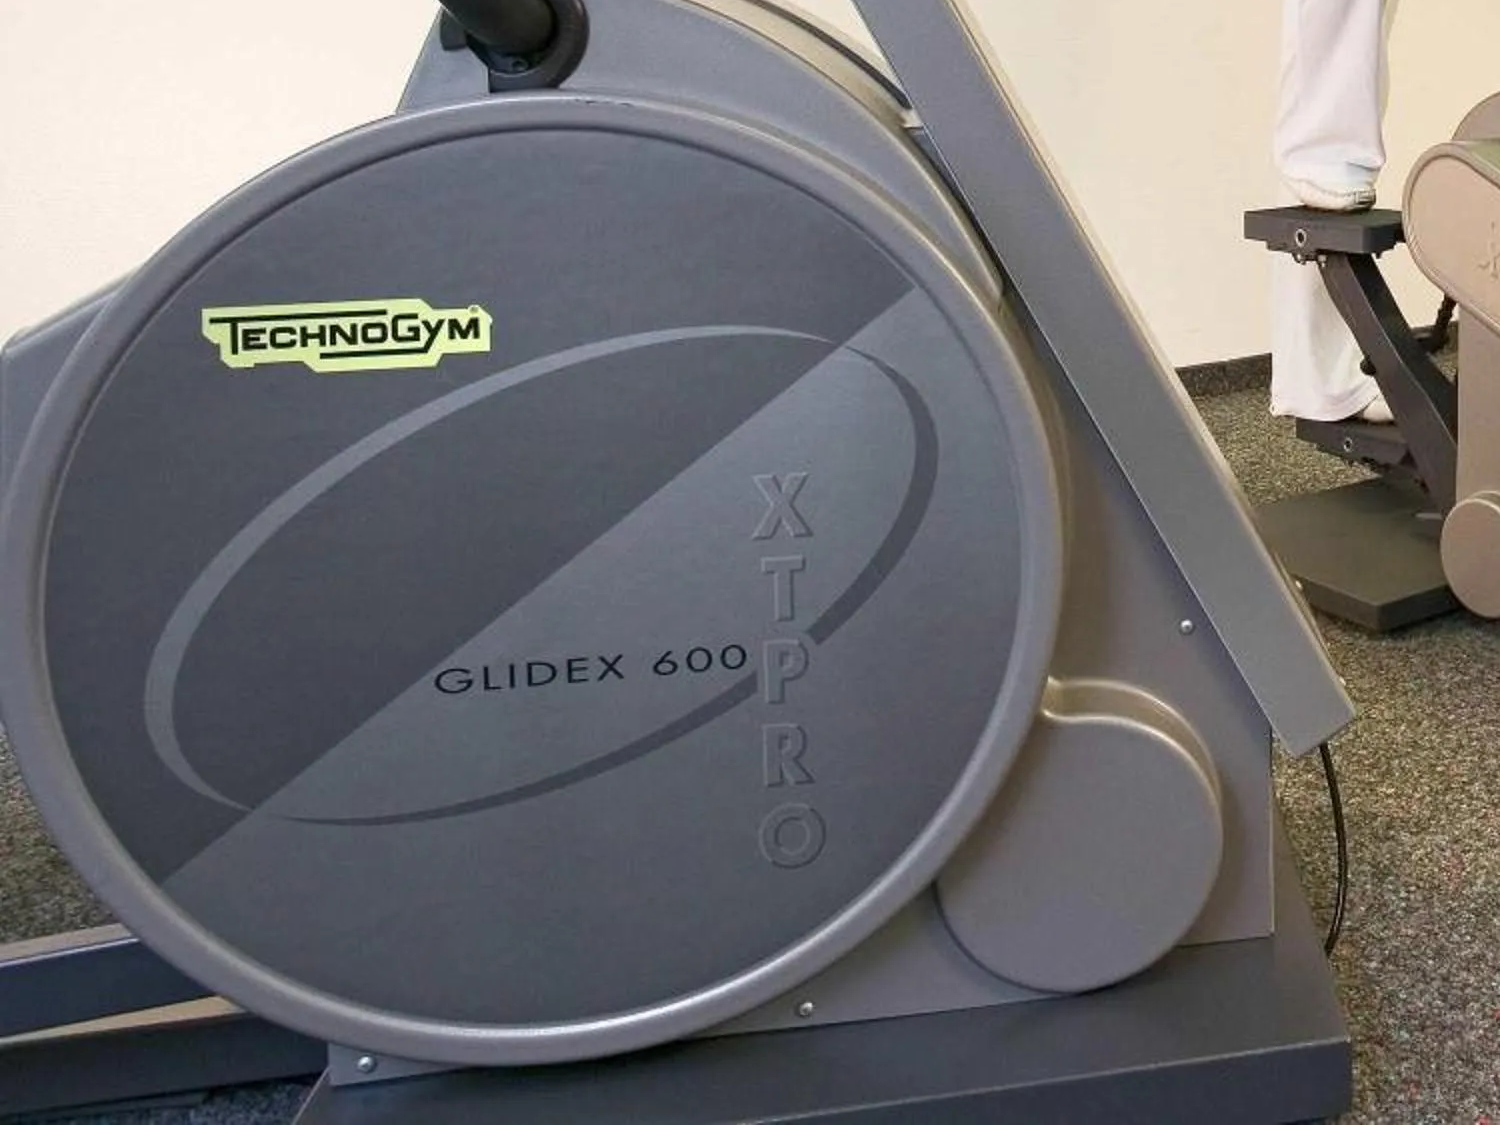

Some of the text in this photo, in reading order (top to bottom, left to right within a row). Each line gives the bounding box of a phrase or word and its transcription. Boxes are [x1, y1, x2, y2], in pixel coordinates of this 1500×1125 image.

[208, 308, 481, 360] TECHNOGYM
[434, 644, 748, 694] GLIDEX 600
